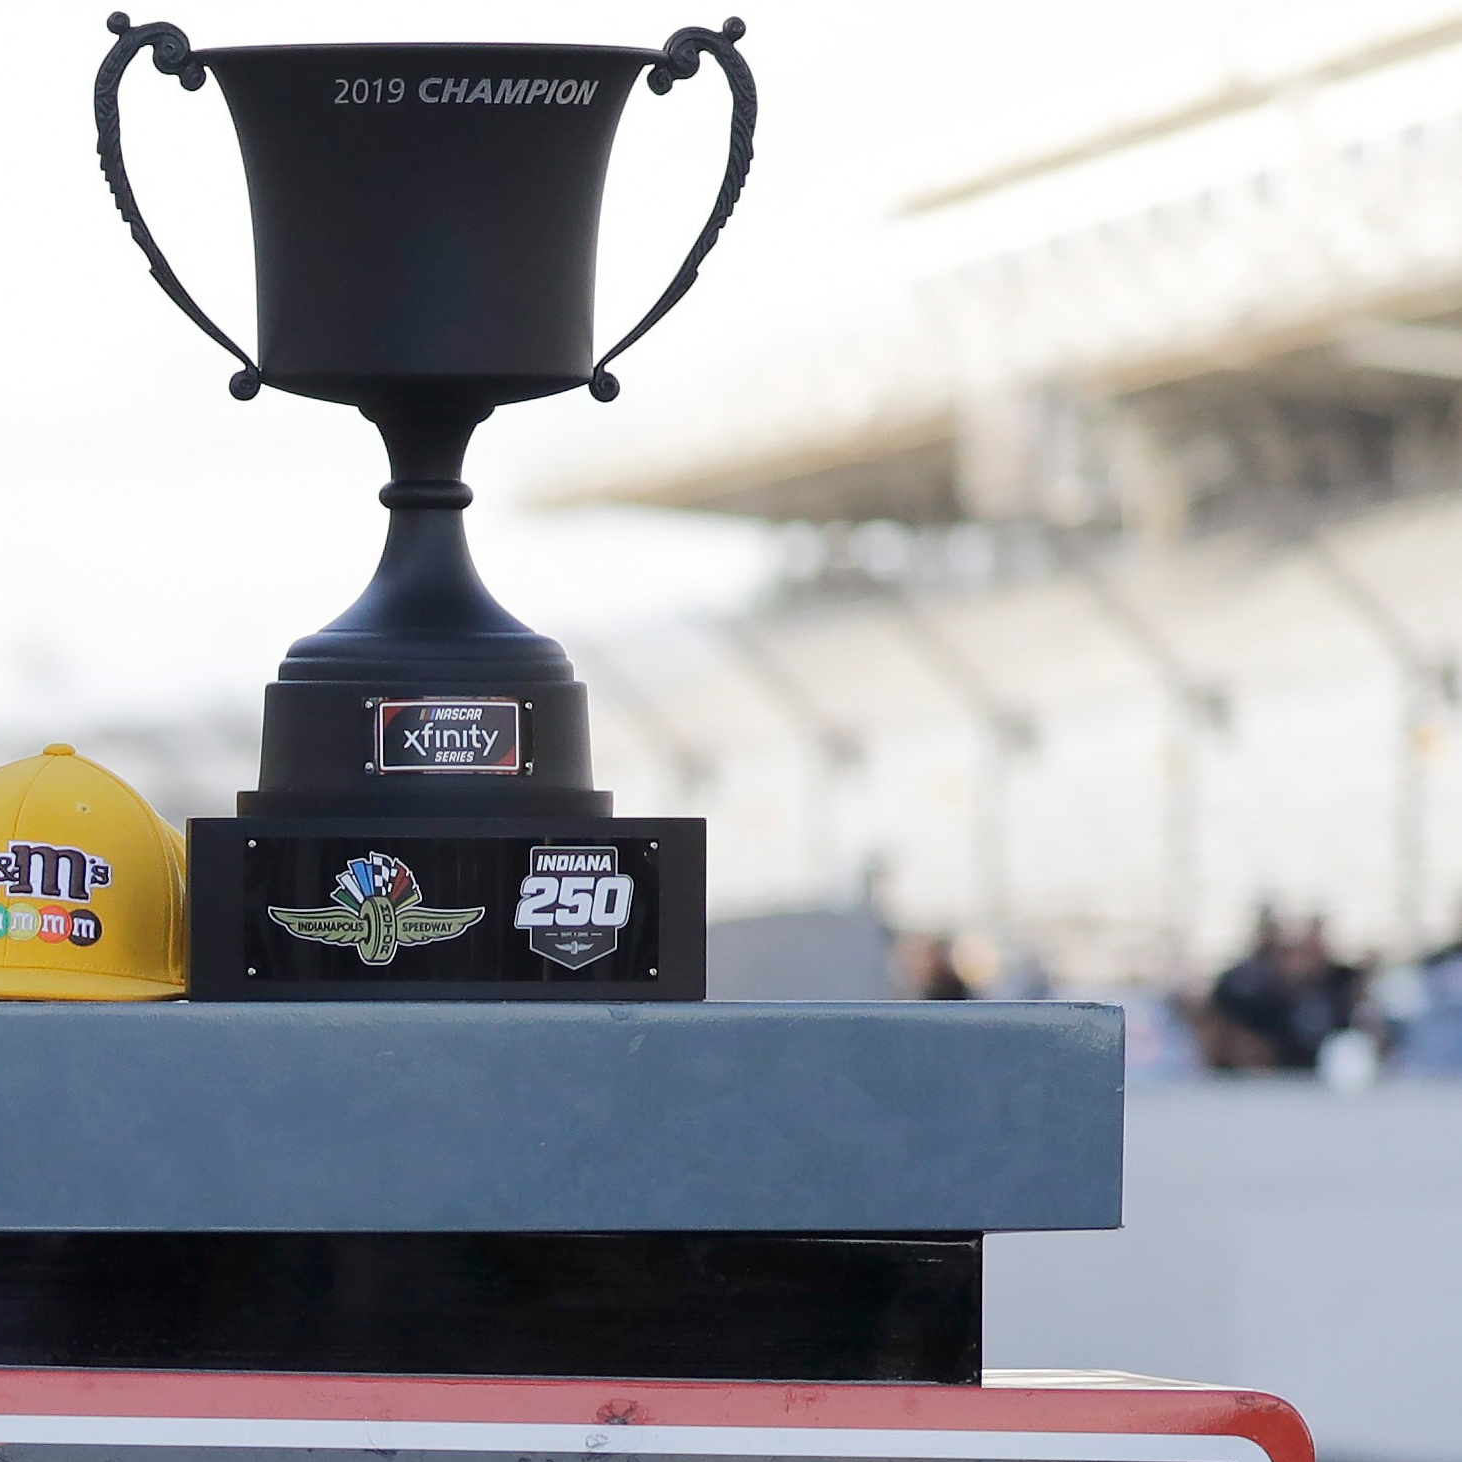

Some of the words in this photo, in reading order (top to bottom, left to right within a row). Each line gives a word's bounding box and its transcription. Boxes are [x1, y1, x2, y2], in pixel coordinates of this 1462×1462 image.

[334, 78, 405, 104] 2019
[418, 77, 599, 106] CHAMPION
[435, 708, 483, 721] NASCAR
[403, 722, 499, 757] xfinity
[434, 751, 475, 763] SERIES
[536, 854, 612, 872] INDIANA
[516, 876, 631, 926] 250
[297, 921, 364, 932] INDIANAPOLIS
[379, 904, 391, 954] MOTOR
[401, 921, 453, 932] SPEEDWAY
